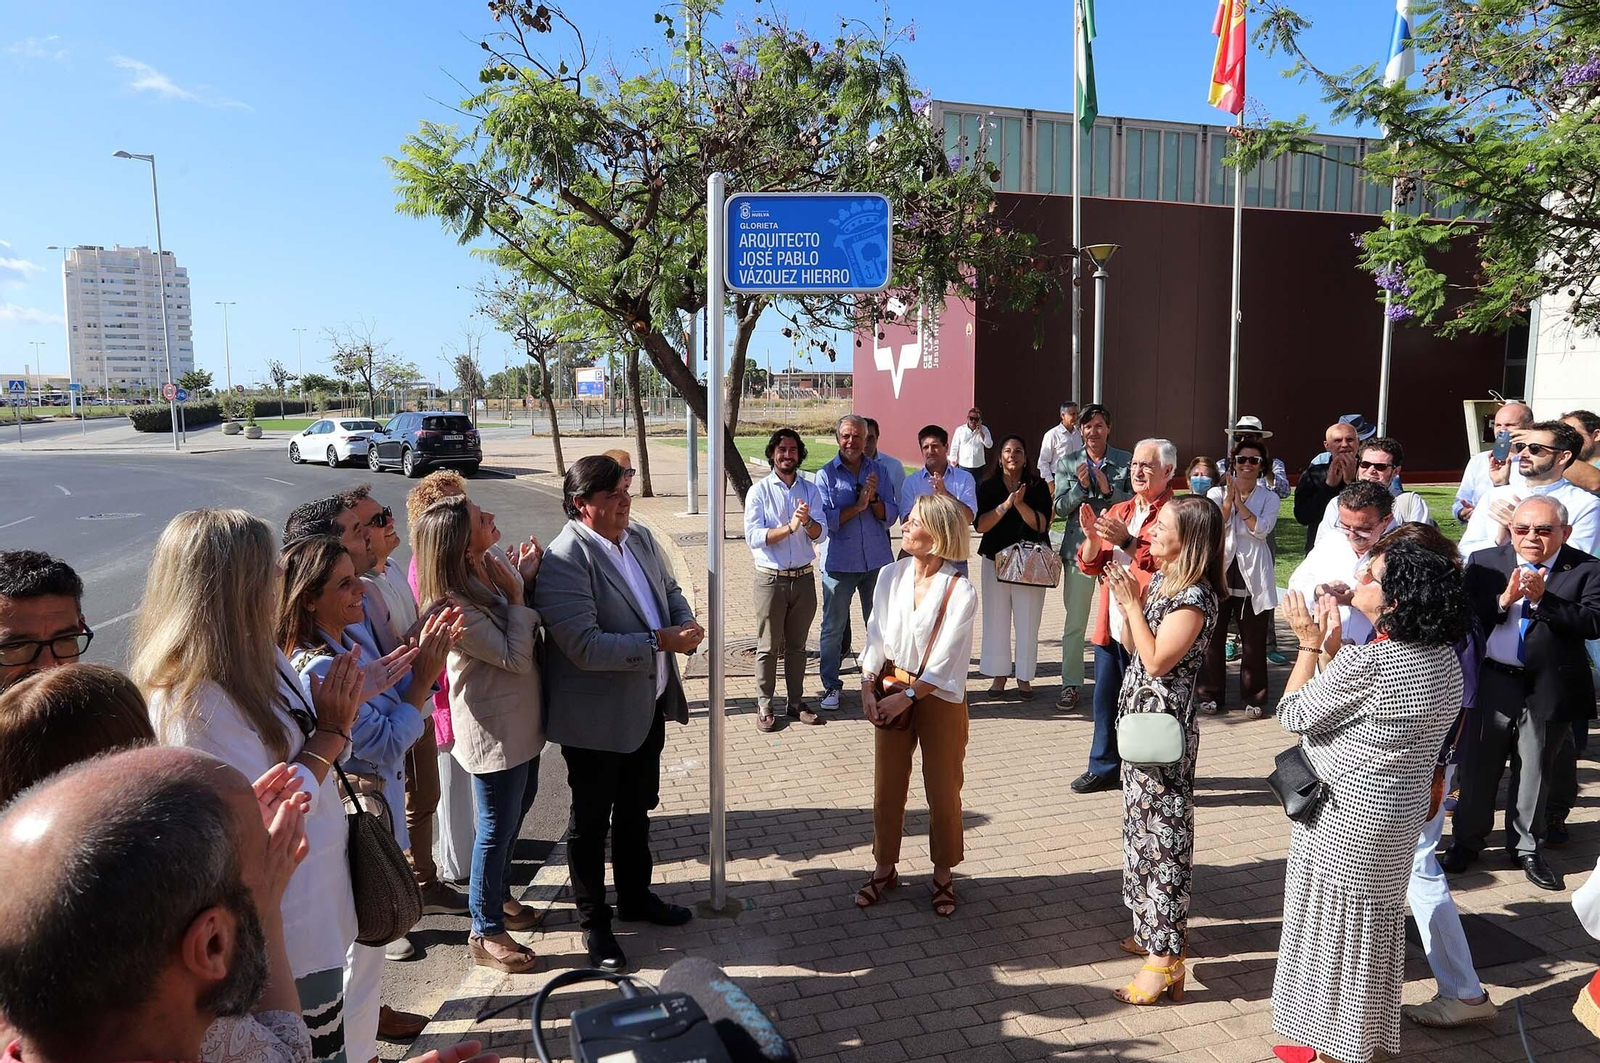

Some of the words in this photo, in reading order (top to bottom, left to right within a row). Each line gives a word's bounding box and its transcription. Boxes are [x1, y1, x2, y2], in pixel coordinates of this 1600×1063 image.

[739, 222, 779, 230] GLORIETA
[739, 232, 820, 248] ARQUITECTO
[739, 248, 773, 266] JOSÉ
[777, 250, 819, 266] PABLO
[739, 267, 798, 285] VÁZQUEZ
[801, 269, 850, 284] HIERRO
[928, 337, 933, 351] LA
[928, 354, 933, 368] DE
